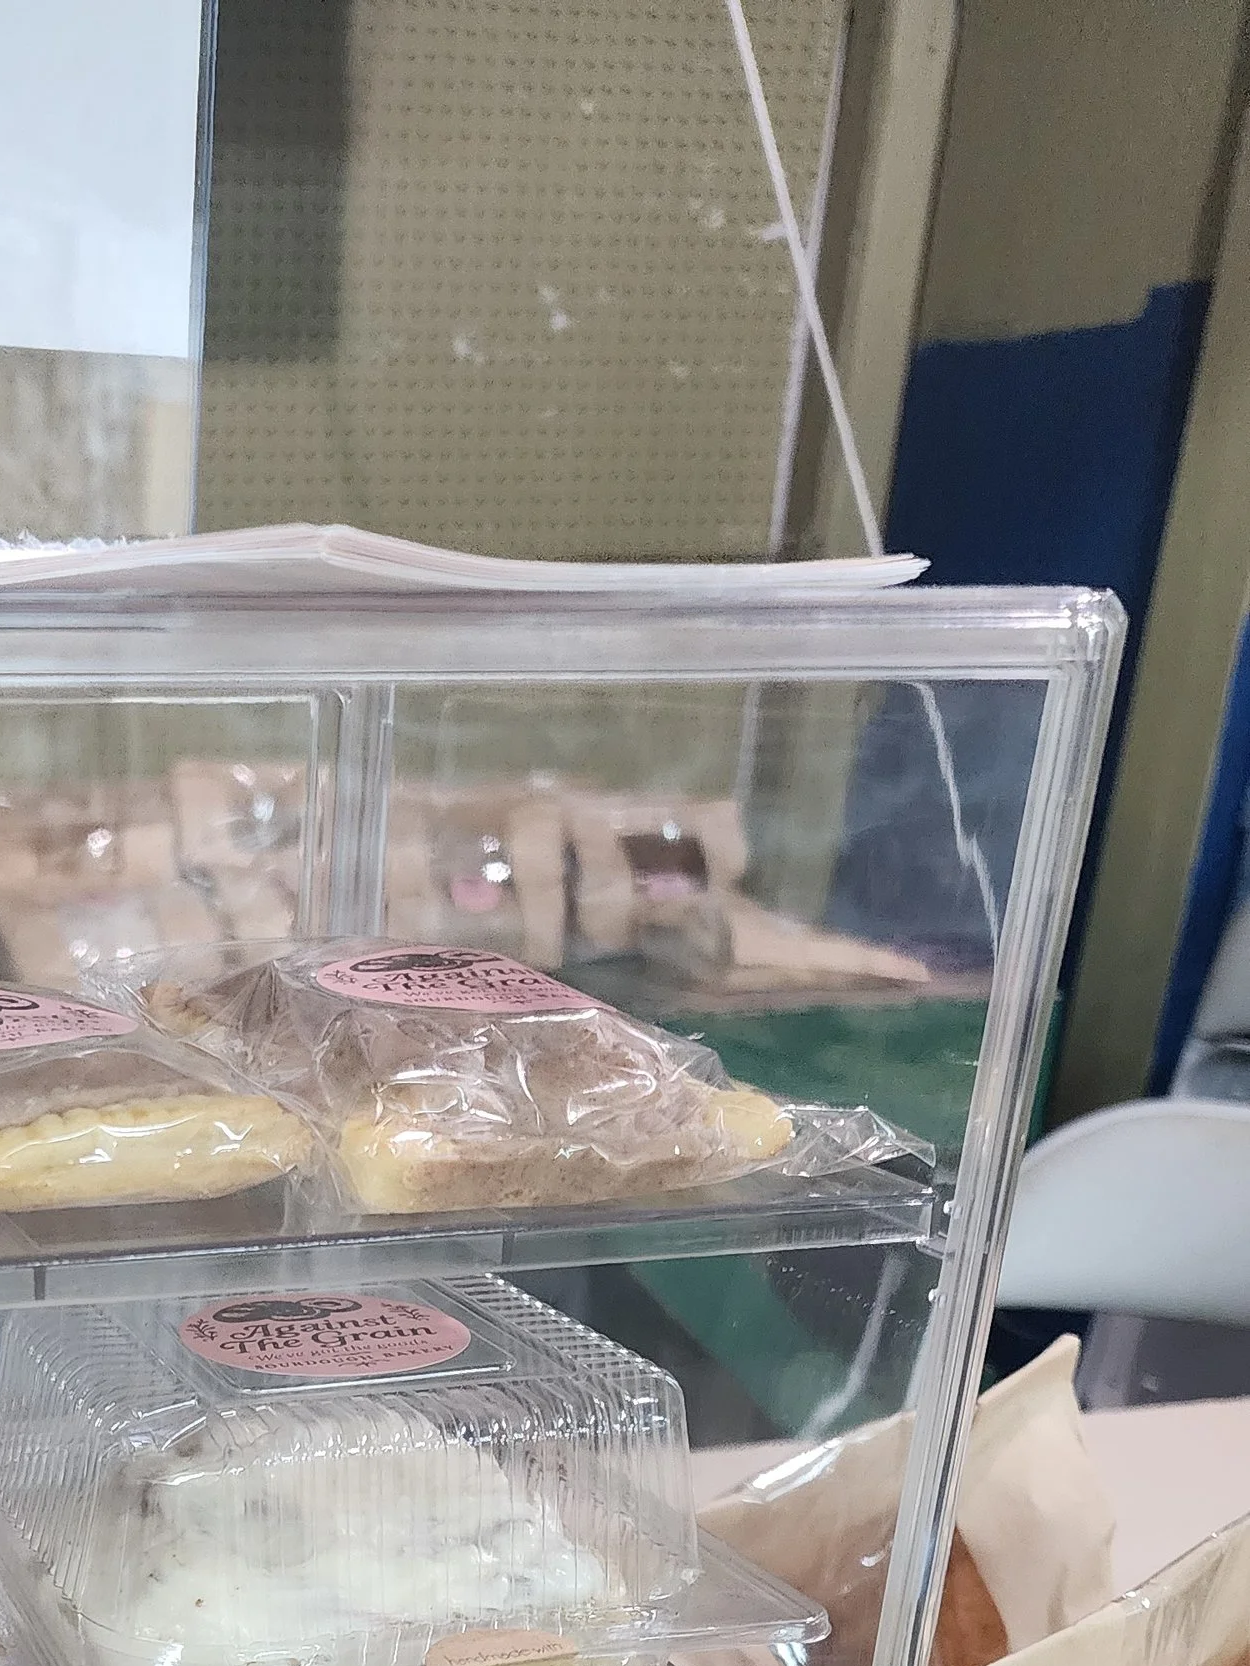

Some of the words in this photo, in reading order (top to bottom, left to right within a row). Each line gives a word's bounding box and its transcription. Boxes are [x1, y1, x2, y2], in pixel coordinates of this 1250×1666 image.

[219, 1336, 301, 1355] The
[310, 1323, 438, 1349] Grain
[229, 1313, 399, 1341] Against
[254, 1354, 373, 1370] SOURDOUGH
